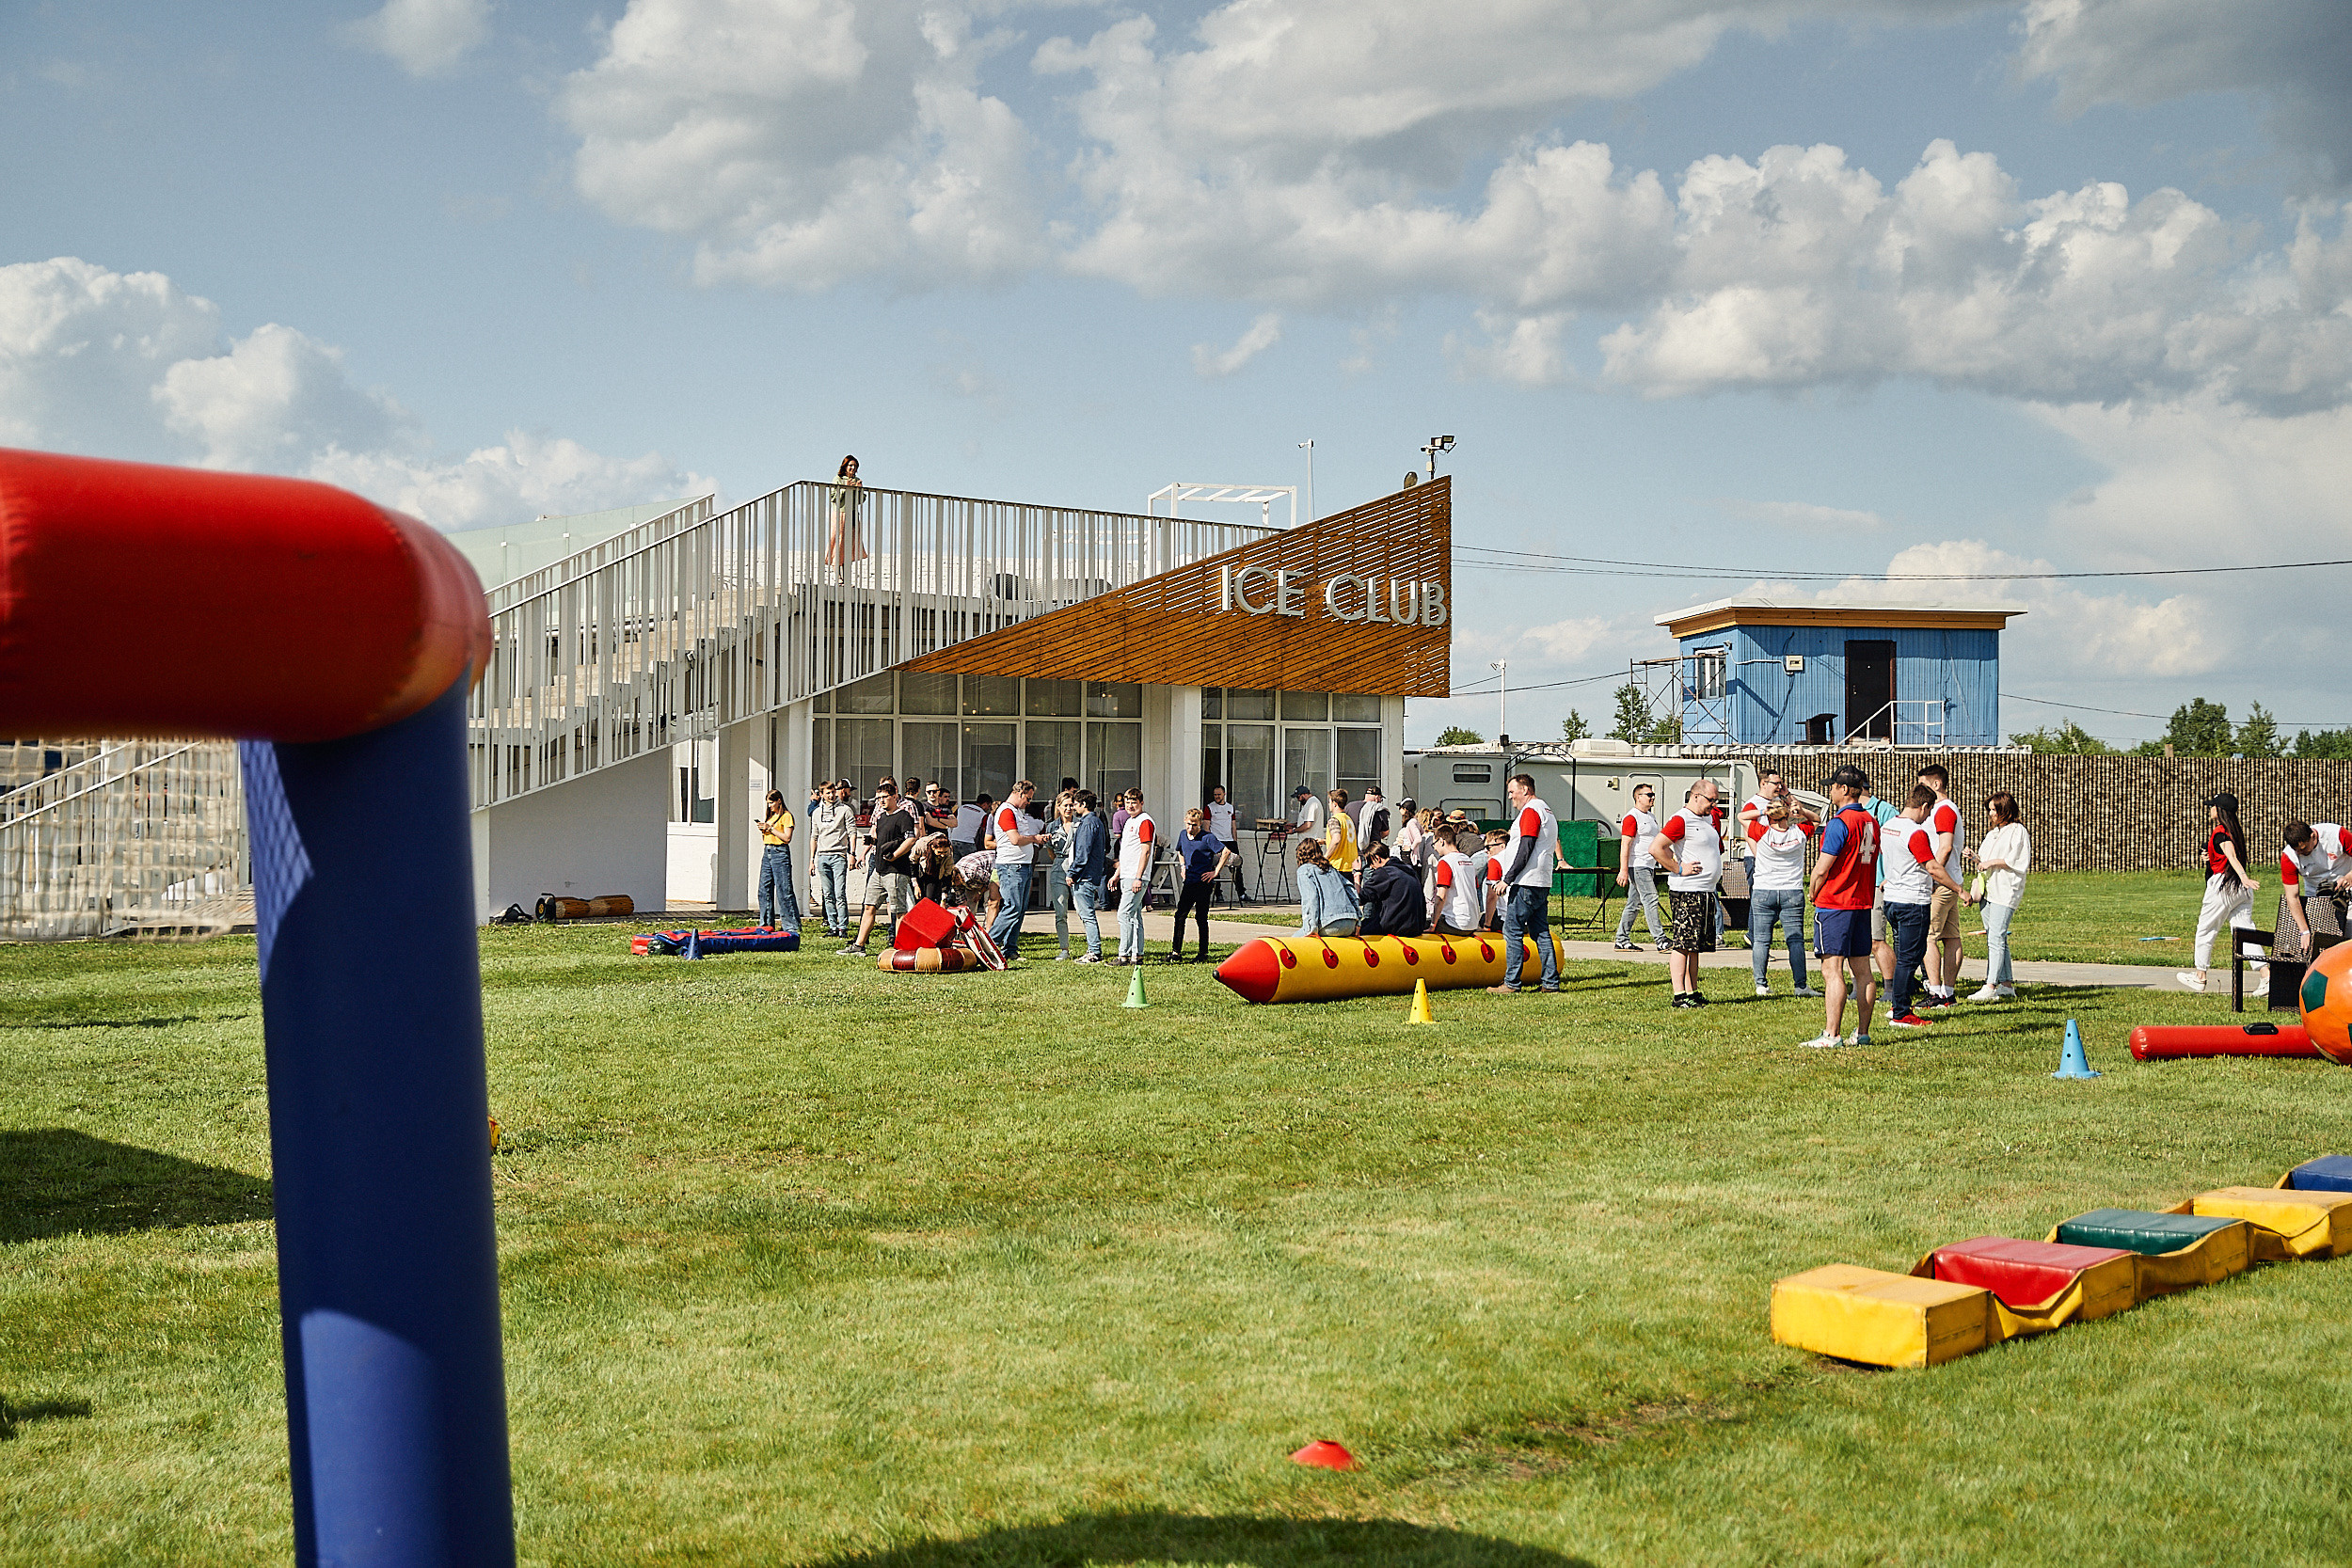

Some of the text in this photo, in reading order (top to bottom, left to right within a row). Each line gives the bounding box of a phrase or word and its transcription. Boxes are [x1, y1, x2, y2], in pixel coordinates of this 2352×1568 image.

[1221, 564, 1447, 626] ICE CLUB
[1346, 818, 1356, 844] 8
[1858, 821, 1877, 864] 4
